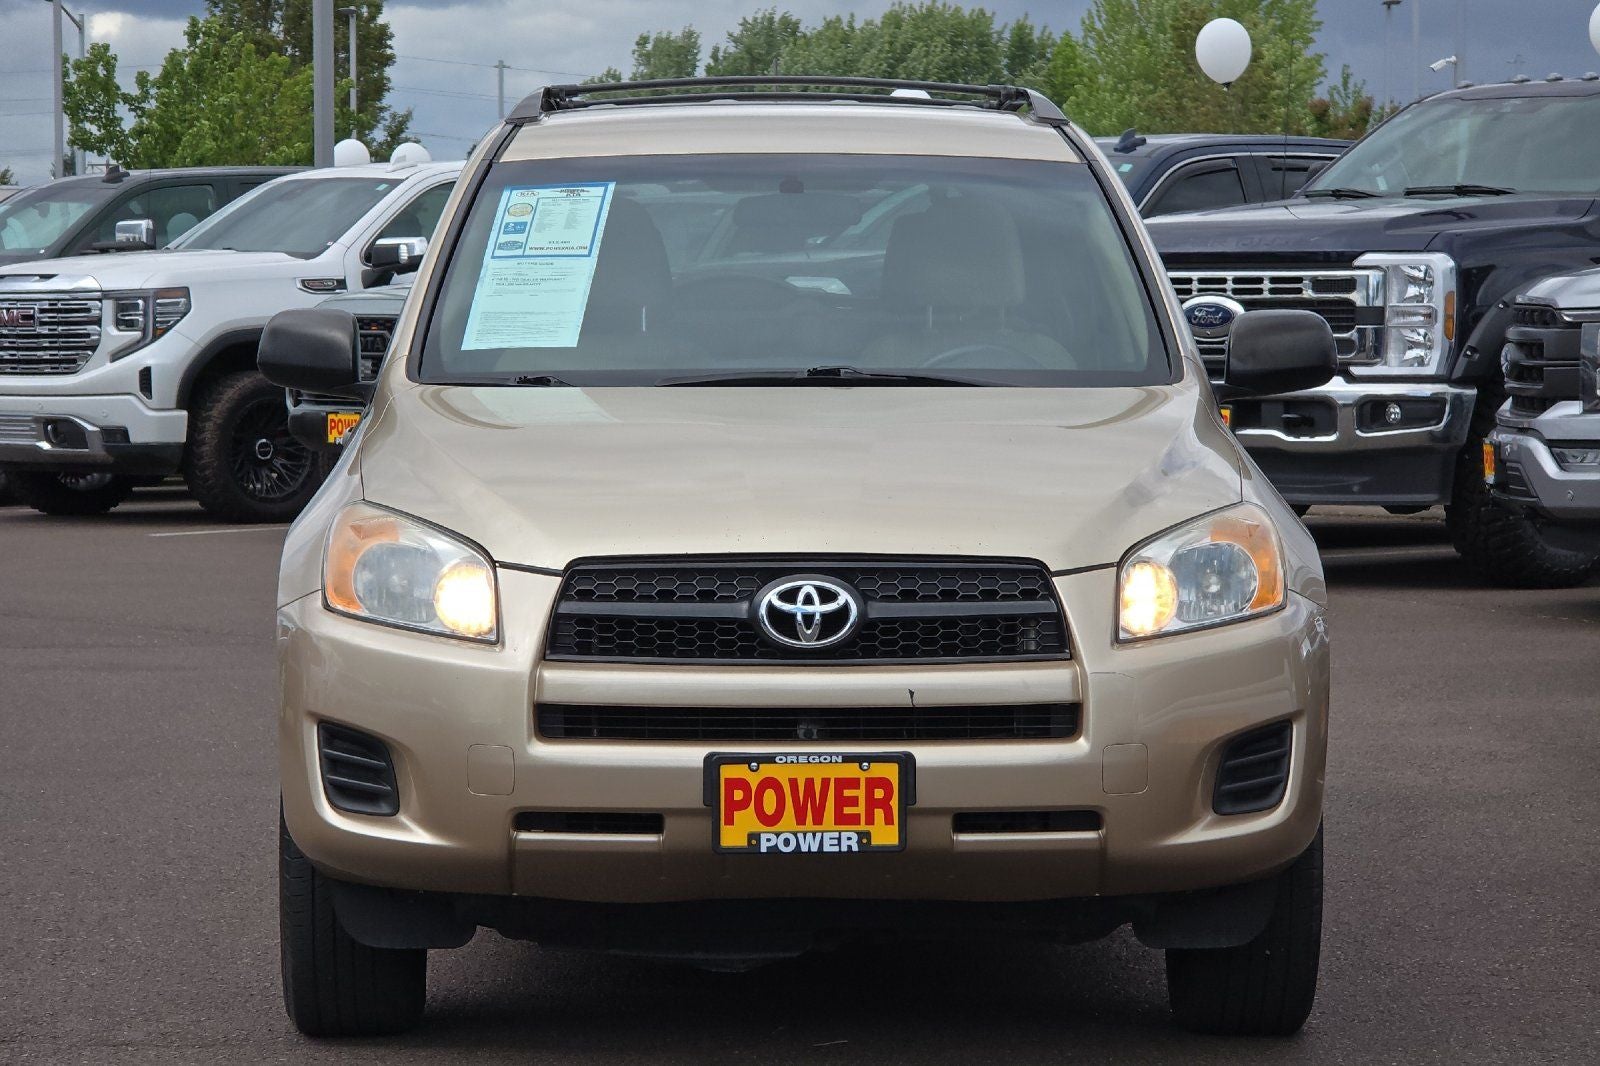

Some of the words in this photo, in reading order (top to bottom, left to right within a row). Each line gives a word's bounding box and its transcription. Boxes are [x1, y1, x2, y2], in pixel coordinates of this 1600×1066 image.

[0, 309, 34, 327] MC
[1191, 306, 1223, 324] Ford
[775, 755, 842, 764] OREGON
[723, 776, 895, 827] POWER
[760, 832, 859, 853] POWER
